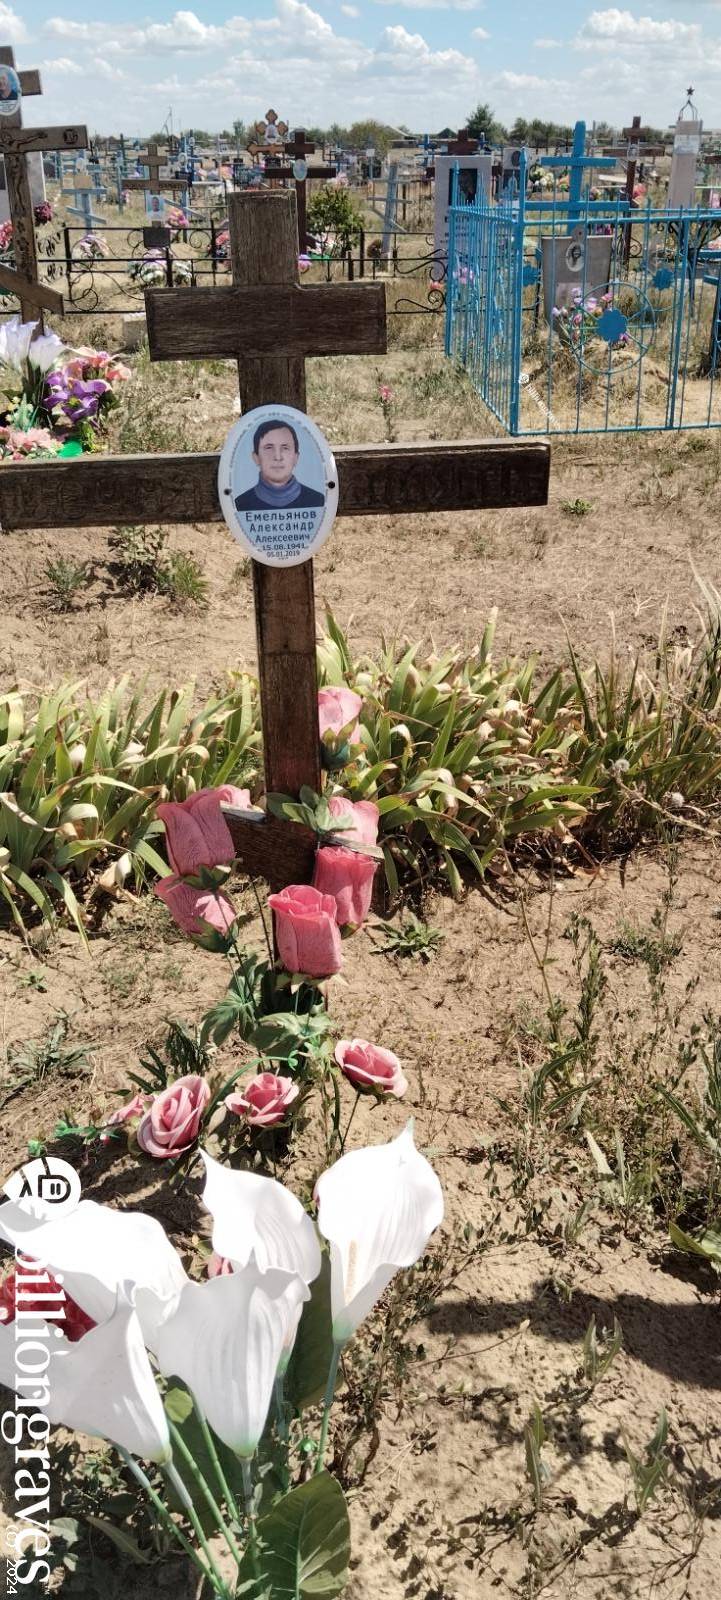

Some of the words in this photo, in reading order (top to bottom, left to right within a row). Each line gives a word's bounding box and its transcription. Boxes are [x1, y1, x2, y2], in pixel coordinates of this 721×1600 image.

[245, 511, 317, 522] Емельянов
[249, 521, 314, 533] Александр
[255, 533, 310, 543] Алексеевич
